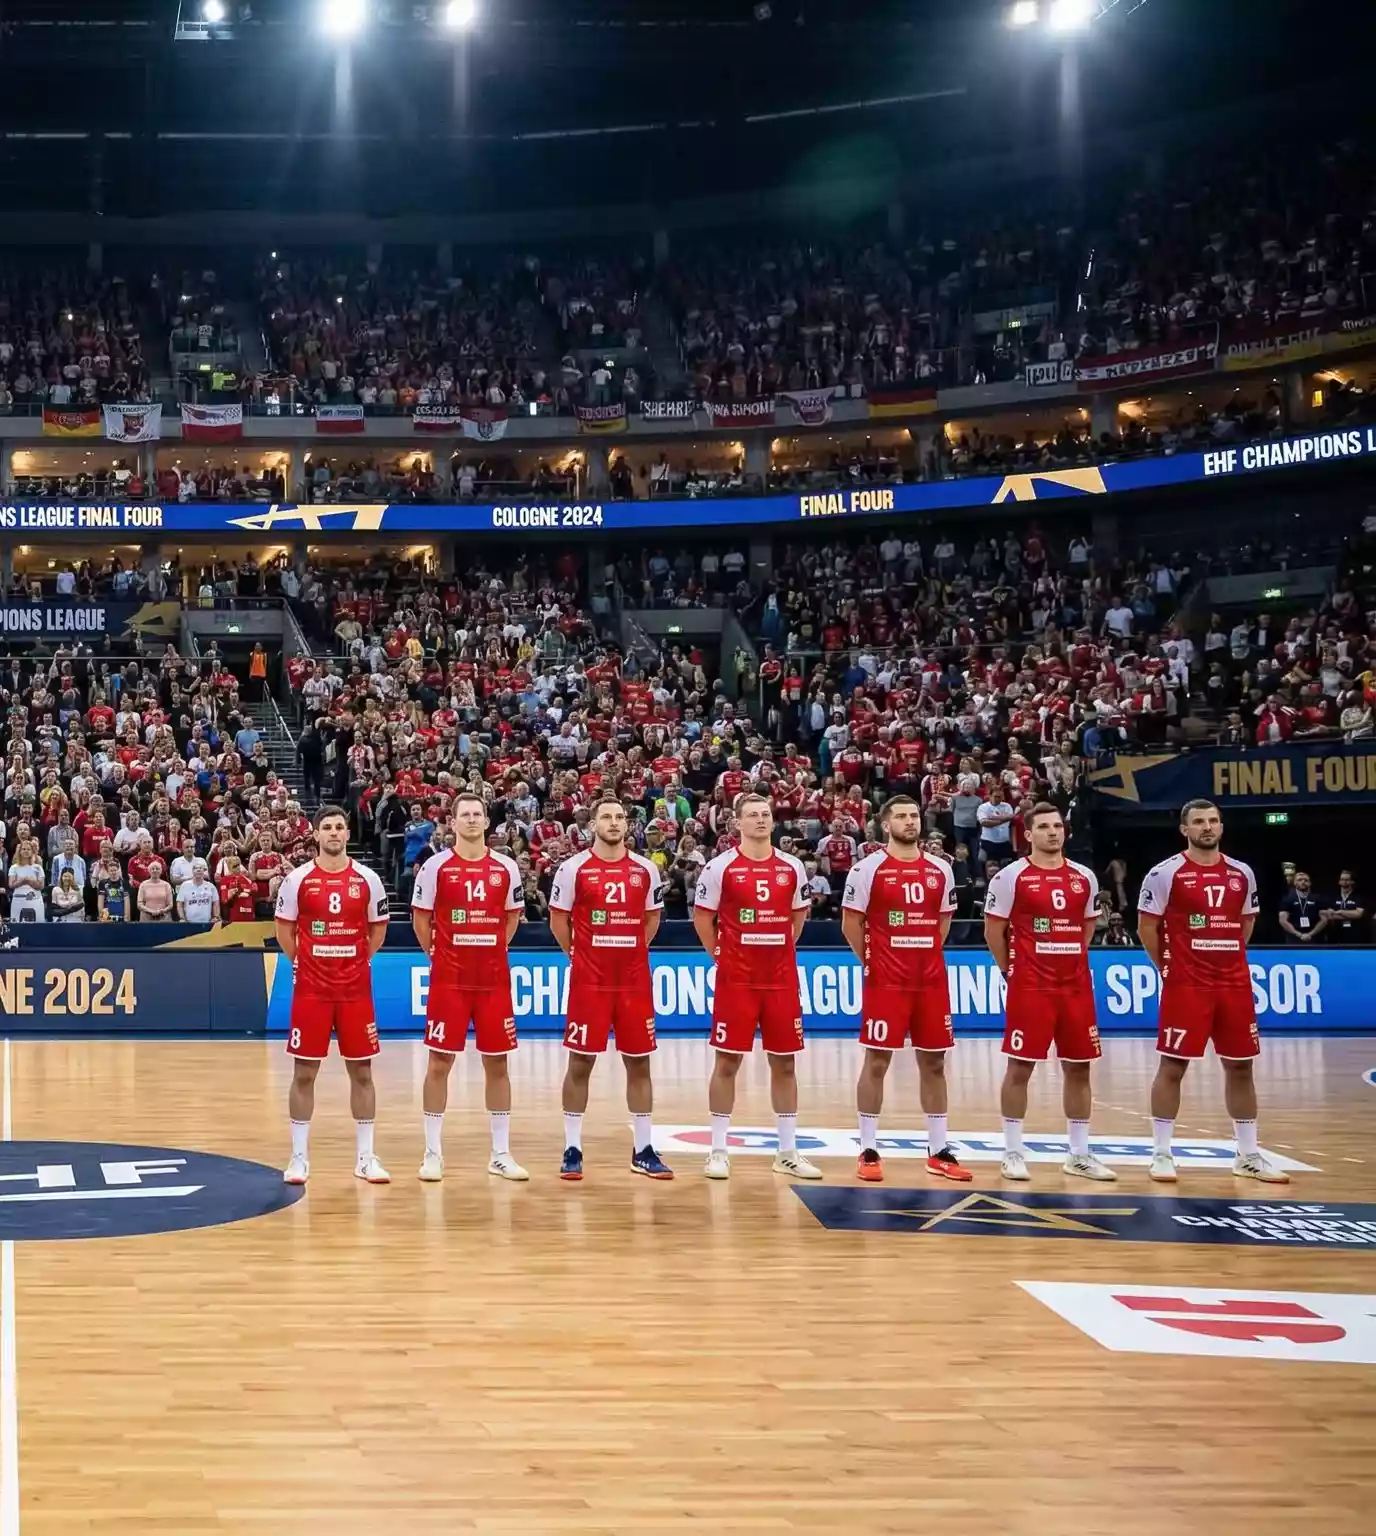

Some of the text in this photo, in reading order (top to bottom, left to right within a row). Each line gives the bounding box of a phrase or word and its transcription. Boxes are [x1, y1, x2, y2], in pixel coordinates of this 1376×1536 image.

[1204, 450, 1237, 475] EHF
[1243, 431, 1361, 468] CHAMPIONS
[800, 489, 894, 517] FINAL FOUR
[20, 507, 74, 527] LEAGUE
[78, 507, 119, 527] FINAL
[124, 507, 162, 527] FOUR
[492, 505, 603, 527] COLOGNE 2024
[46, 608, 105, 631] LEAGUE
[1213, 761, 1298, 795] FINAL
[465, 880, 486, 902] 14
[605, 882, 626, 903] 21
[756, 880, 770, 902] 5
[902, 882, 924, 904] 10
[1051, 889, 1066, 910] 6
[1204, 885, 1225, 908] 17
[329, 892, 341, 914] 8
[44, 968, 137, 1015] 2024
[290, 1027, 301, 1049] 8
[428, 1020, 445, 1043] 14
[567, 1022, 588, 1045] 21
[716, 1022, 727, 1043] 5
[866, 1019, 888, 1042] 10
[1010, 1029, 1023, 1050] 6
[1164, 1027, 1187, 1050] 17
[1228, 1205, 1325, 1214] EHF
